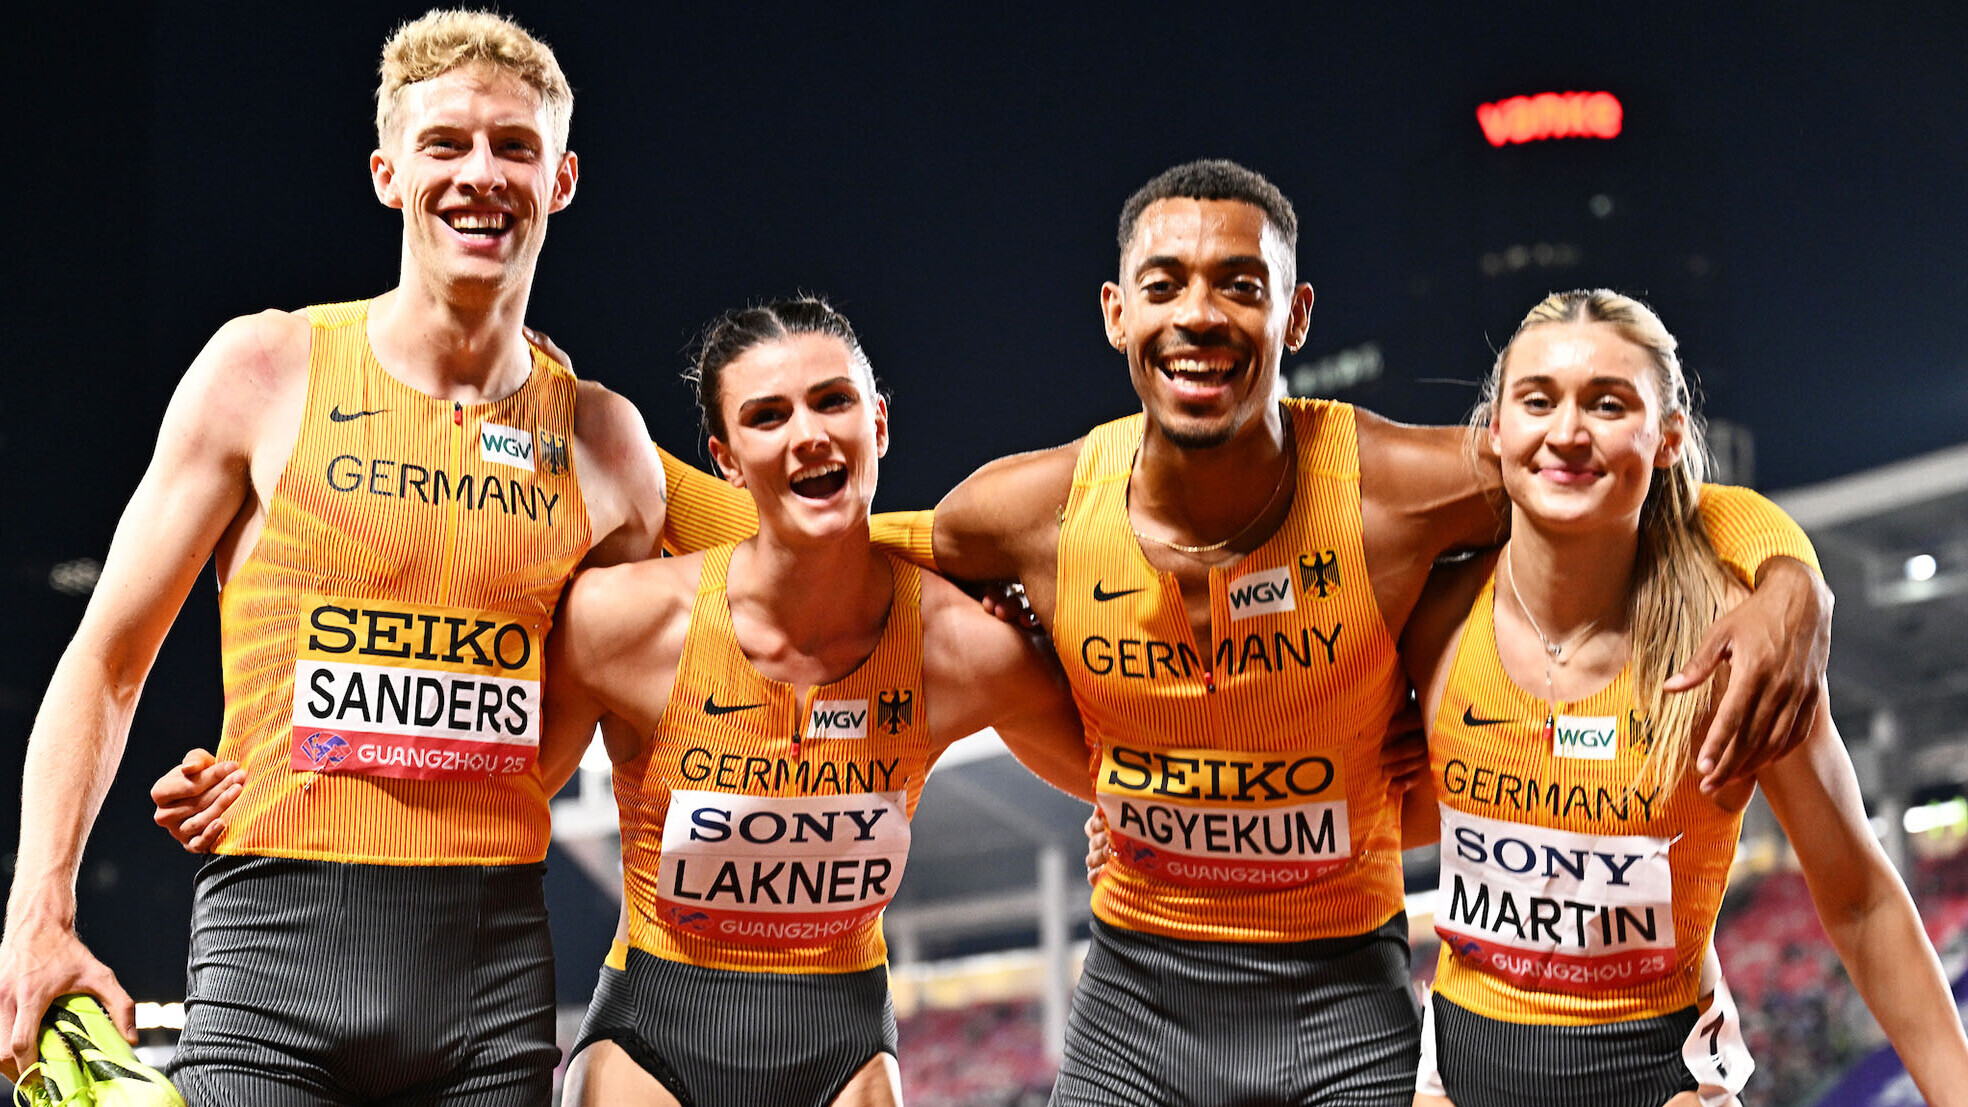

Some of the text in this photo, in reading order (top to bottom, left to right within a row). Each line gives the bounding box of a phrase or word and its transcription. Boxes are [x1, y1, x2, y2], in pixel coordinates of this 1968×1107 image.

[481, 431, 532, 462] WGV
[326, 453, 559, 527] GERMANY
[1229, 577, 1290, 610] WGV
[308, 605, 531, 671] SEIKO
[1081, 622, 1343, 679] GERMANY
[306, 667, 529, 737] SANDERS
[812, 709, 867, 730] WGV
[356, 742, 527, 774] GUANGZHOU 25
[1556, 726, 1615, 749] WGV
[680, 746, 900, 794] GERMANY
[1108, 745, 1335, 803] SEIKO
[1443, 758, 1660, 823] GERMANY
[689, 807, 889, 845] SONY
[1119, 800, 1337, 856] AGYEKUM
[1166, 860, 1310, 884] GUANGZHOU
[1453, 826, 1644, 887] SONY
[672, 857, 893, 905] LAKNER
[719, 915, 857, 940] GUANGZHOU
[1448, 873, 1659, 949] MARTIN
[1490, 951, 1667, 984] GUANGZHOU 25
